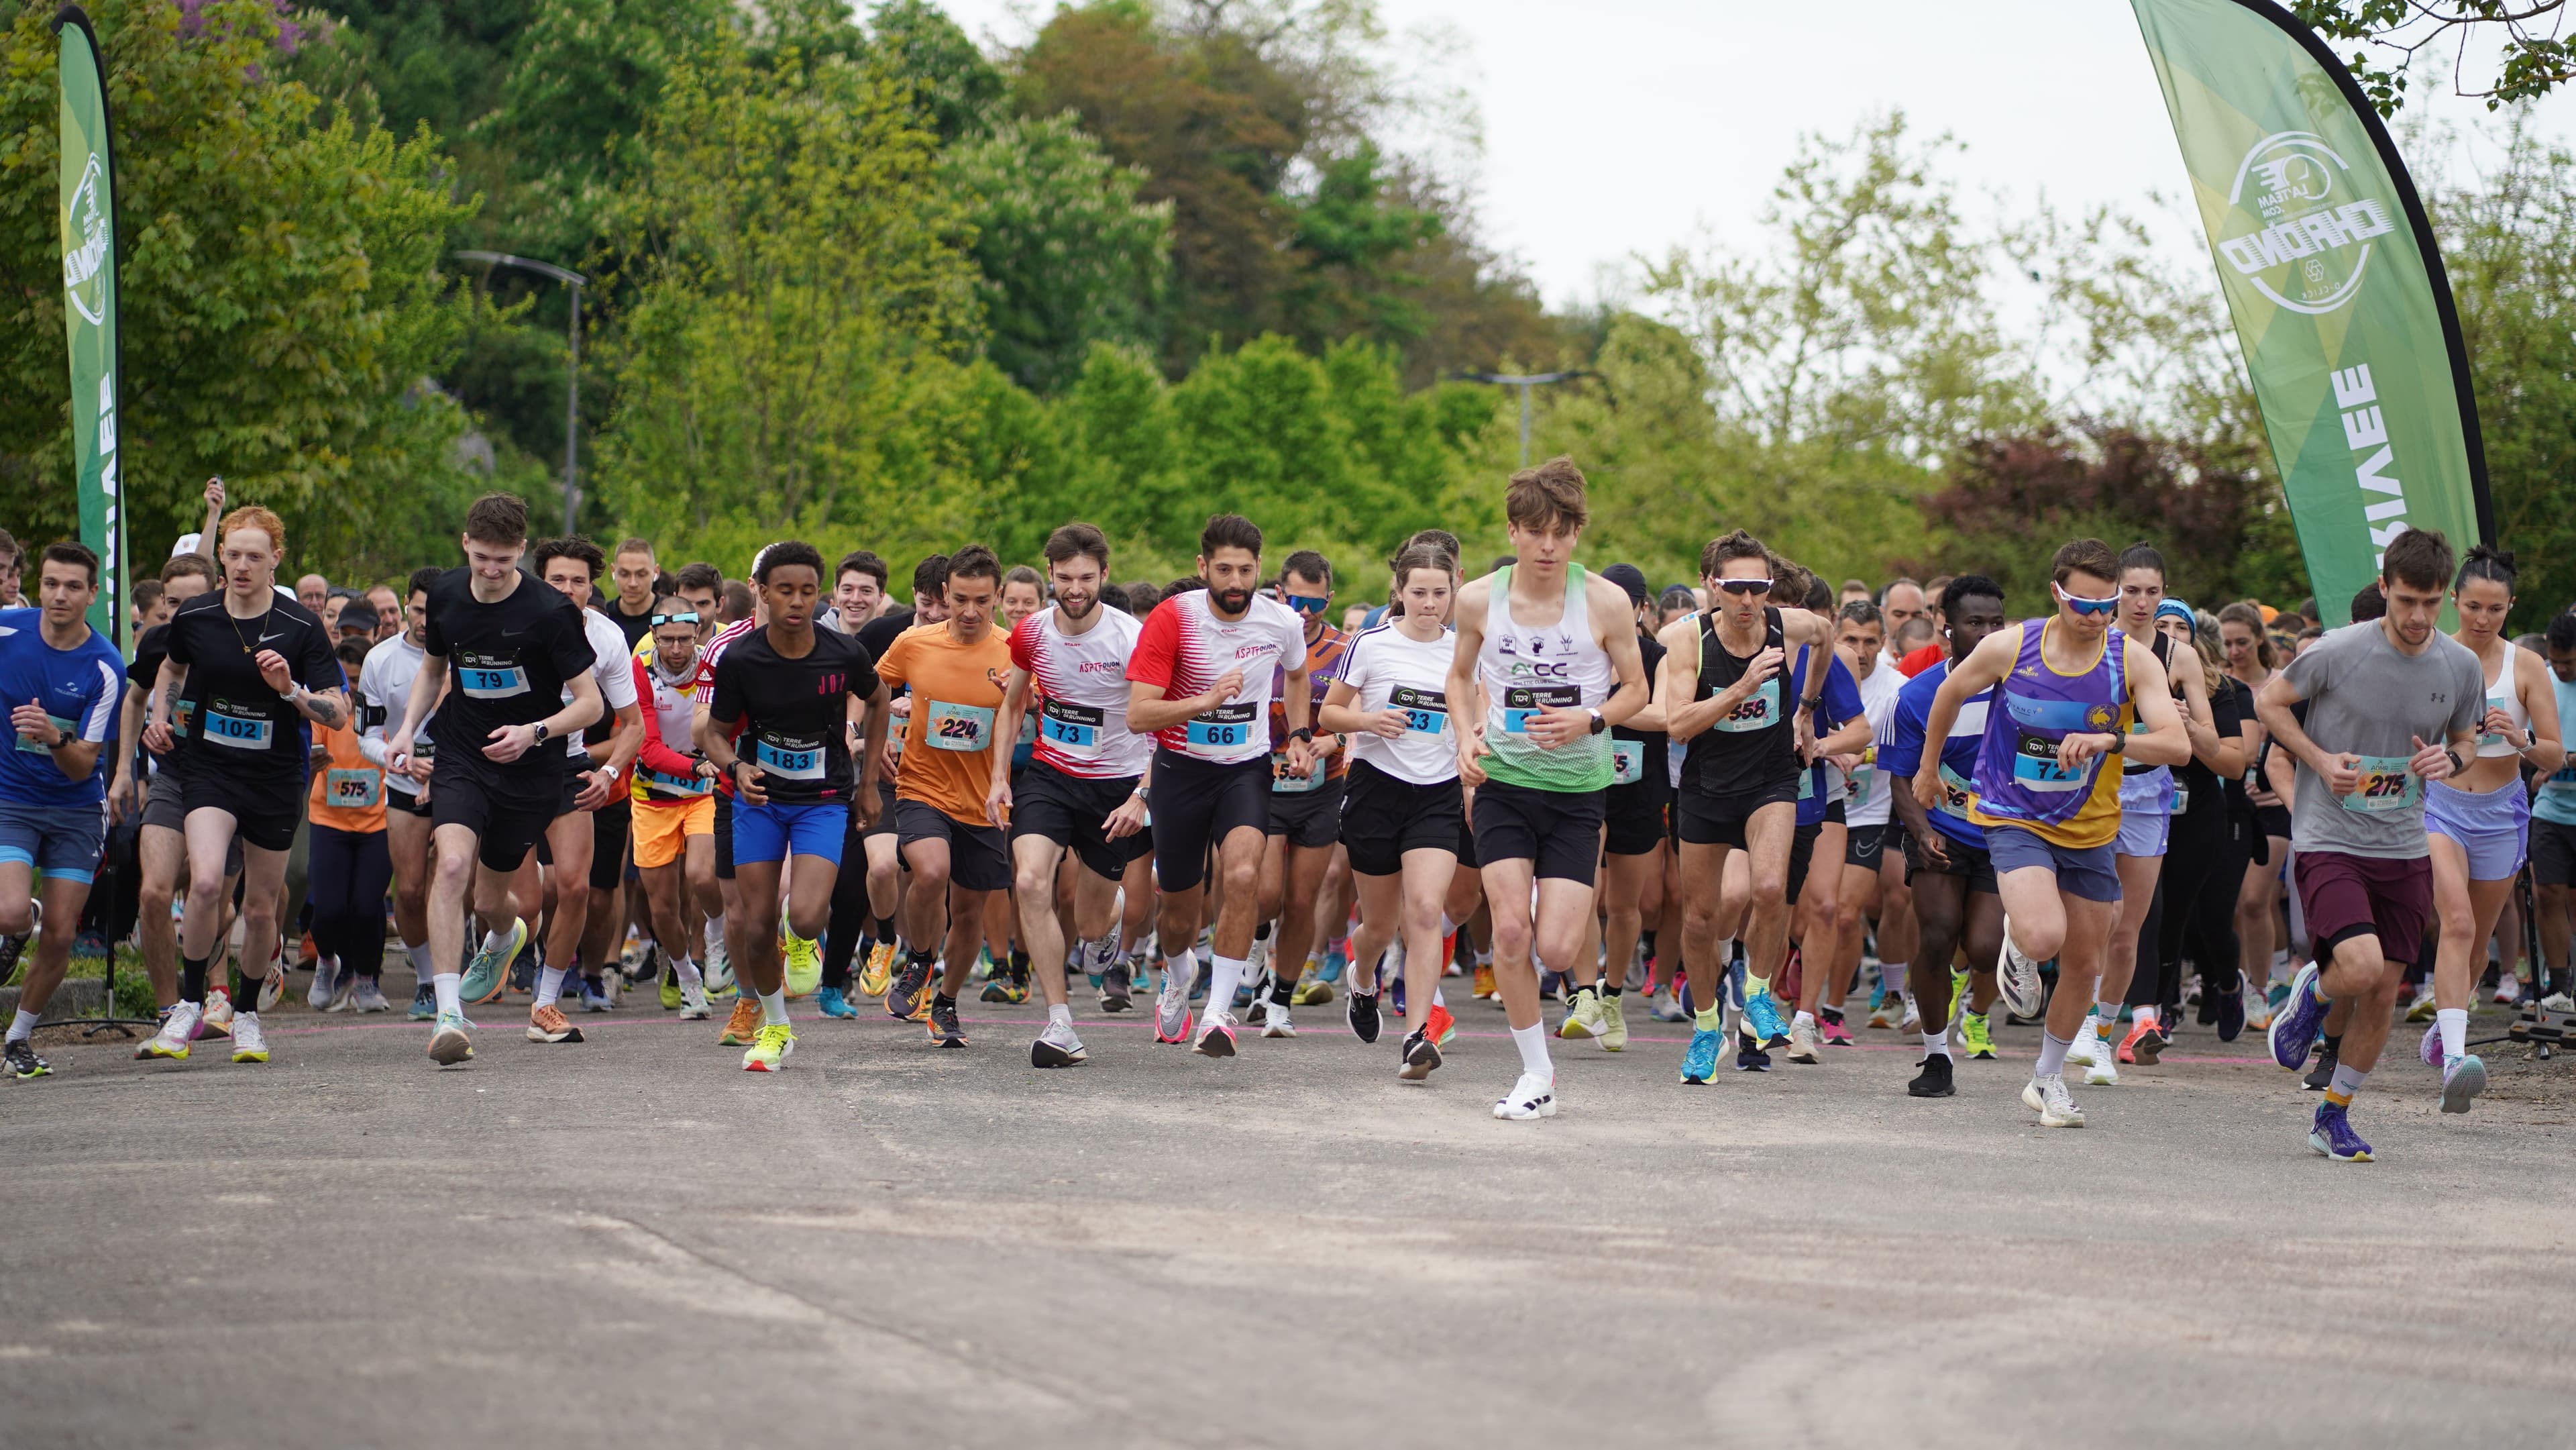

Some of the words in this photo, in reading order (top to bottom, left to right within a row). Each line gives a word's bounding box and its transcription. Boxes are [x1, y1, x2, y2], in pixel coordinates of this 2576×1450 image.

[1235, 646, 1260, 659] ASPTT
[1079, 662, 1102, 672] ASPTT
[476, 672, 502, 688] 79
[1401, 694, 1413, 702] TDR
[216, 702, 227, 710] TDR
[1049, 705, 1059, 715] TDR
[1068, 715, 1096, 723] RUNNING
[217, 719, 256, 738] 102
[940, 719, 978, 739] 224
[1055, 723, 1079, 743] 73
[1208, 726, 1234, 744] 66
[767, 734, 780, 743] TDR
[2029, 742, 2043, 752] TDR
[769, 750, 809, 769] 183
[2037, 761, 2066, 780] 72
[341, 782, 366, 797] 575
[2365, 774, 2406, 797] 275
[1947, 785, 1968, 806] 56
